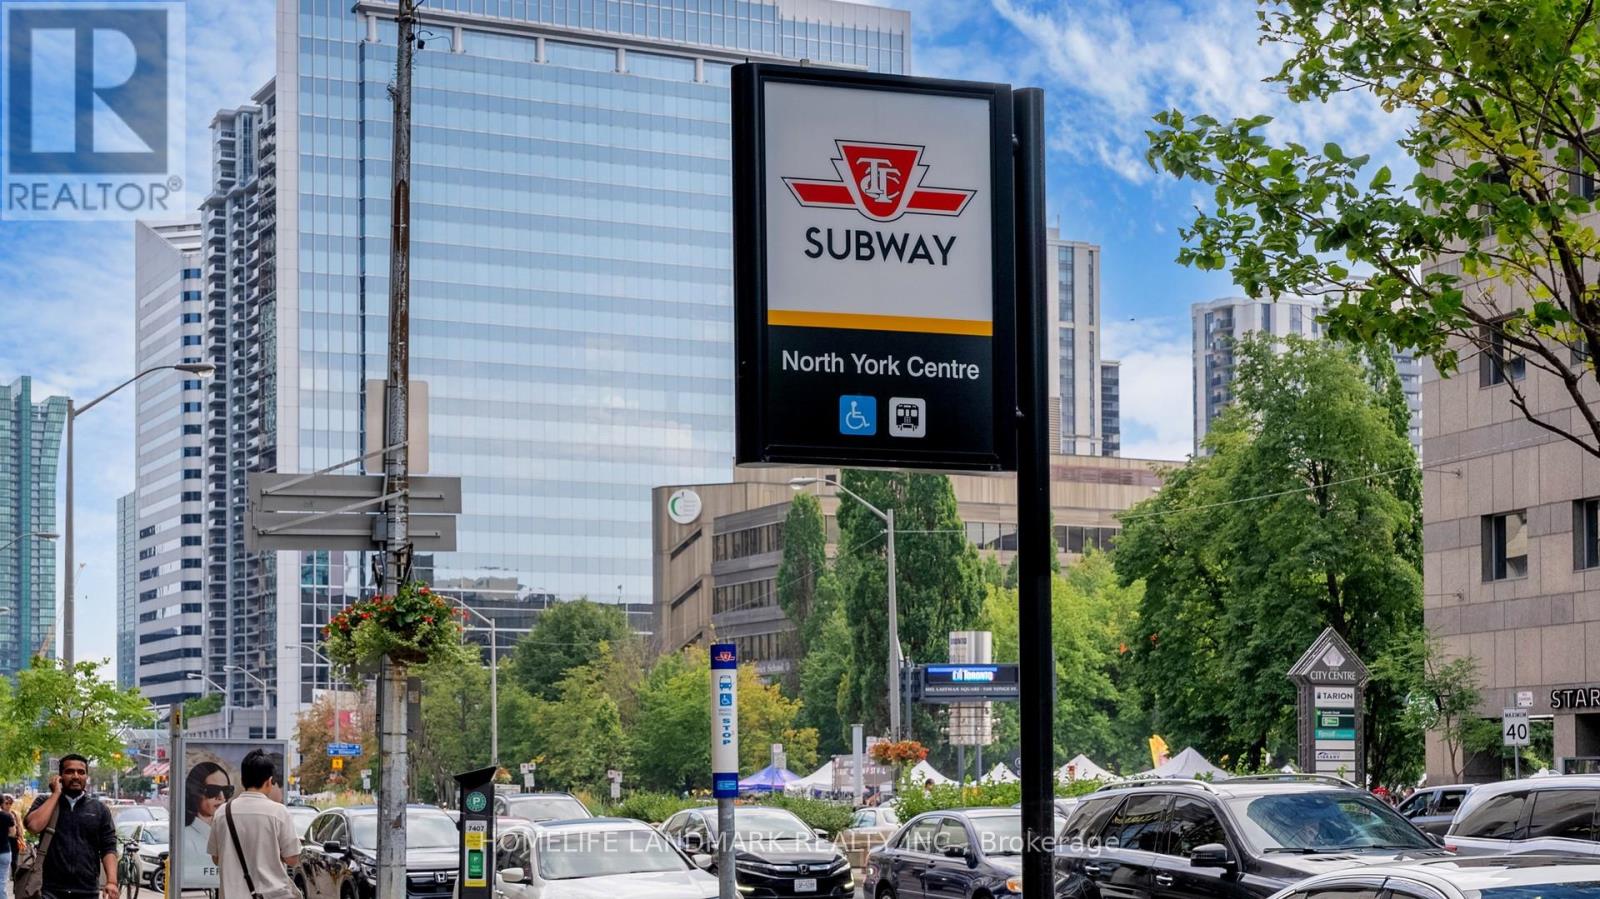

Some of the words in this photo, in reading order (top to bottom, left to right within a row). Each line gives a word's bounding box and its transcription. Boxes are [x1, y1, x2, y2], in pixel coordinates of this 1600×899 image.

[804, 226, 957, 266] SUBWAY
[782, 350, 844, 373] North
[850, 353, 900, 376] York
[907, 356, 980, 380] Centre
[1310, 670, 1327, 680] CITY
[1328, 670, 1357, 681] CENTRE
[1322, 692, 1353, 700] TARION
[722, 718, 731, 745] STOP
[1506, 723, 1527, 740] 40
